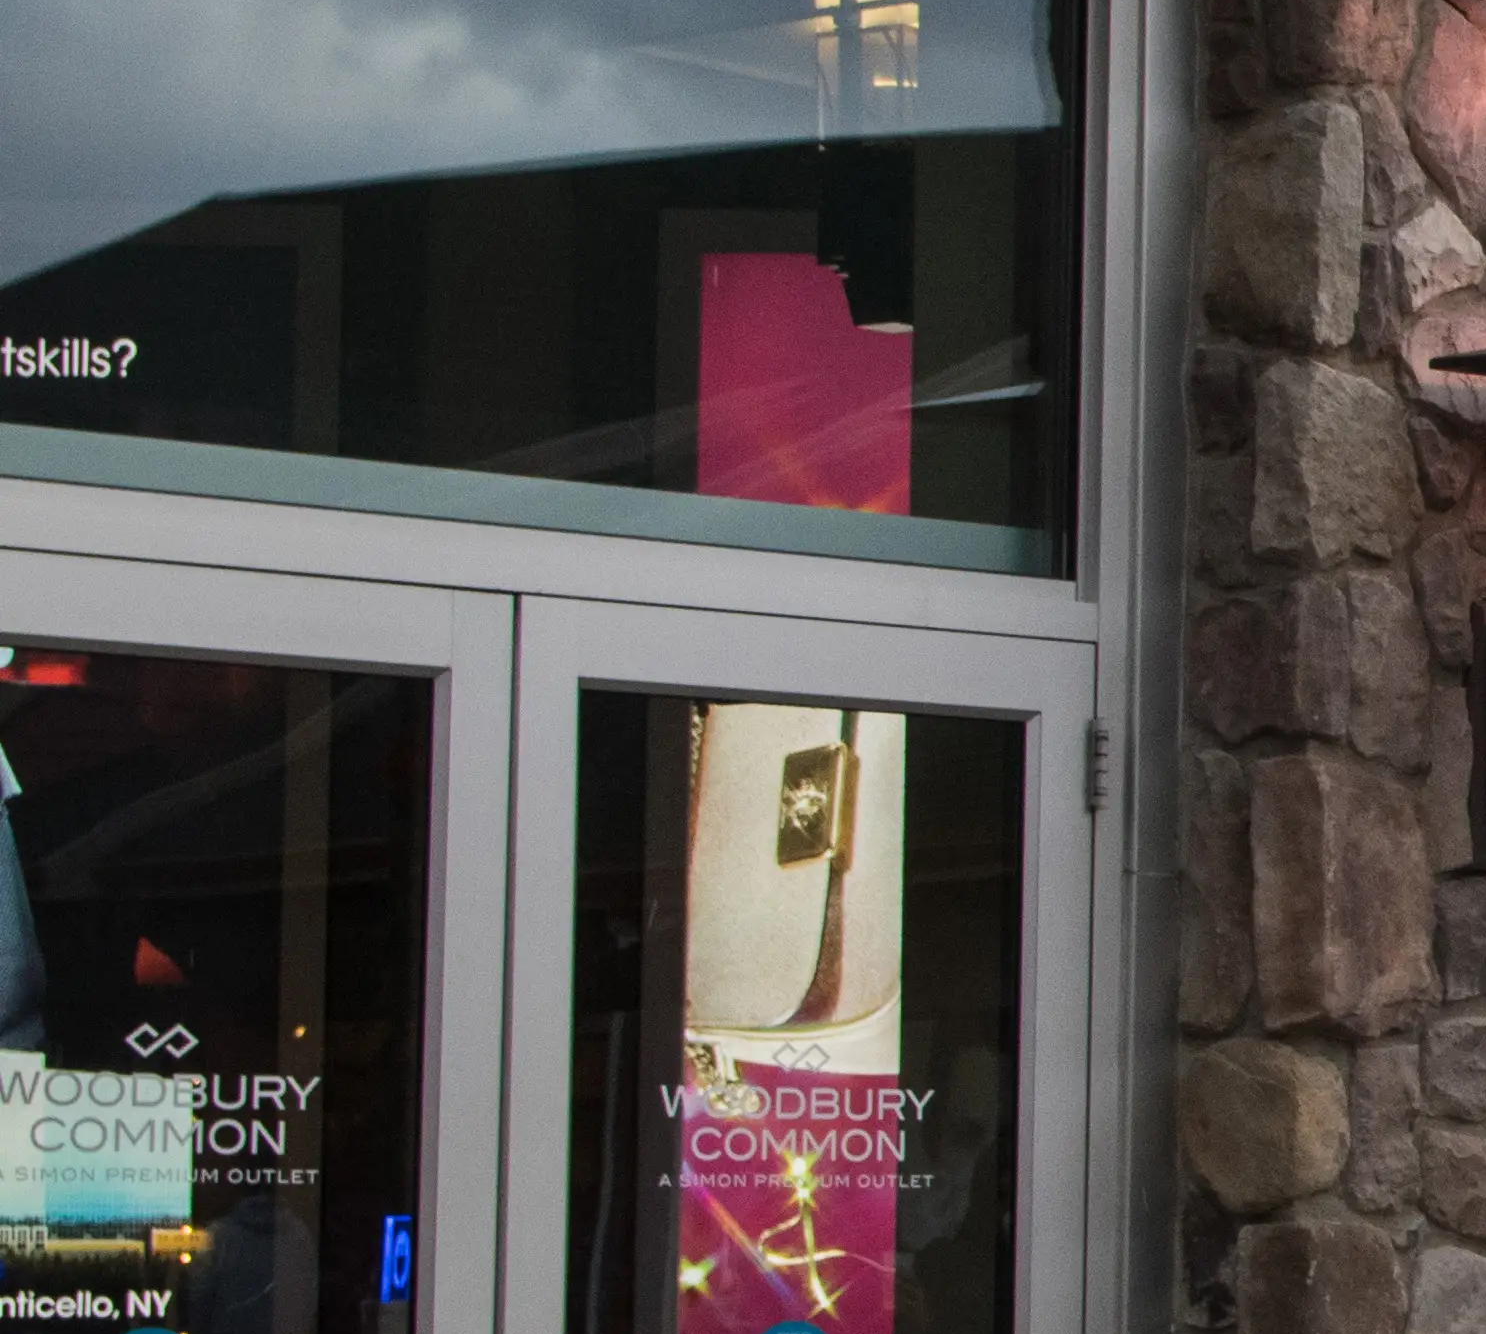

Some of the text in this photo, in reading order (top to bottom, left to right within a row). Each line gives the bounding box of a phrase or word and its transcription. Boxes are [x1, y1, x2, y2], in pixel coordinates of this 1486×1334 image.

[0, 336, 139, 378] tskills?
[0, 1070, 321, 1111] WOODBURY
[660, 1083, 935, 1121] WOODBURY
[30, 1116, 287, 1156] COMMON
[690, 1126, 907, 1162] COMMON
[14, 1167, 96, 1183] SIMON
[105, 1168, 219, 1184] PREMIUM
[228, 1169, 319, 1185] OUTLET
[658, 1173, 672, 1188] A
[679, 1173, 747, 1188] SIMON
[859, 1174, 935, 1189] OUTLET
[126, 1289, 172, 1318] NY
